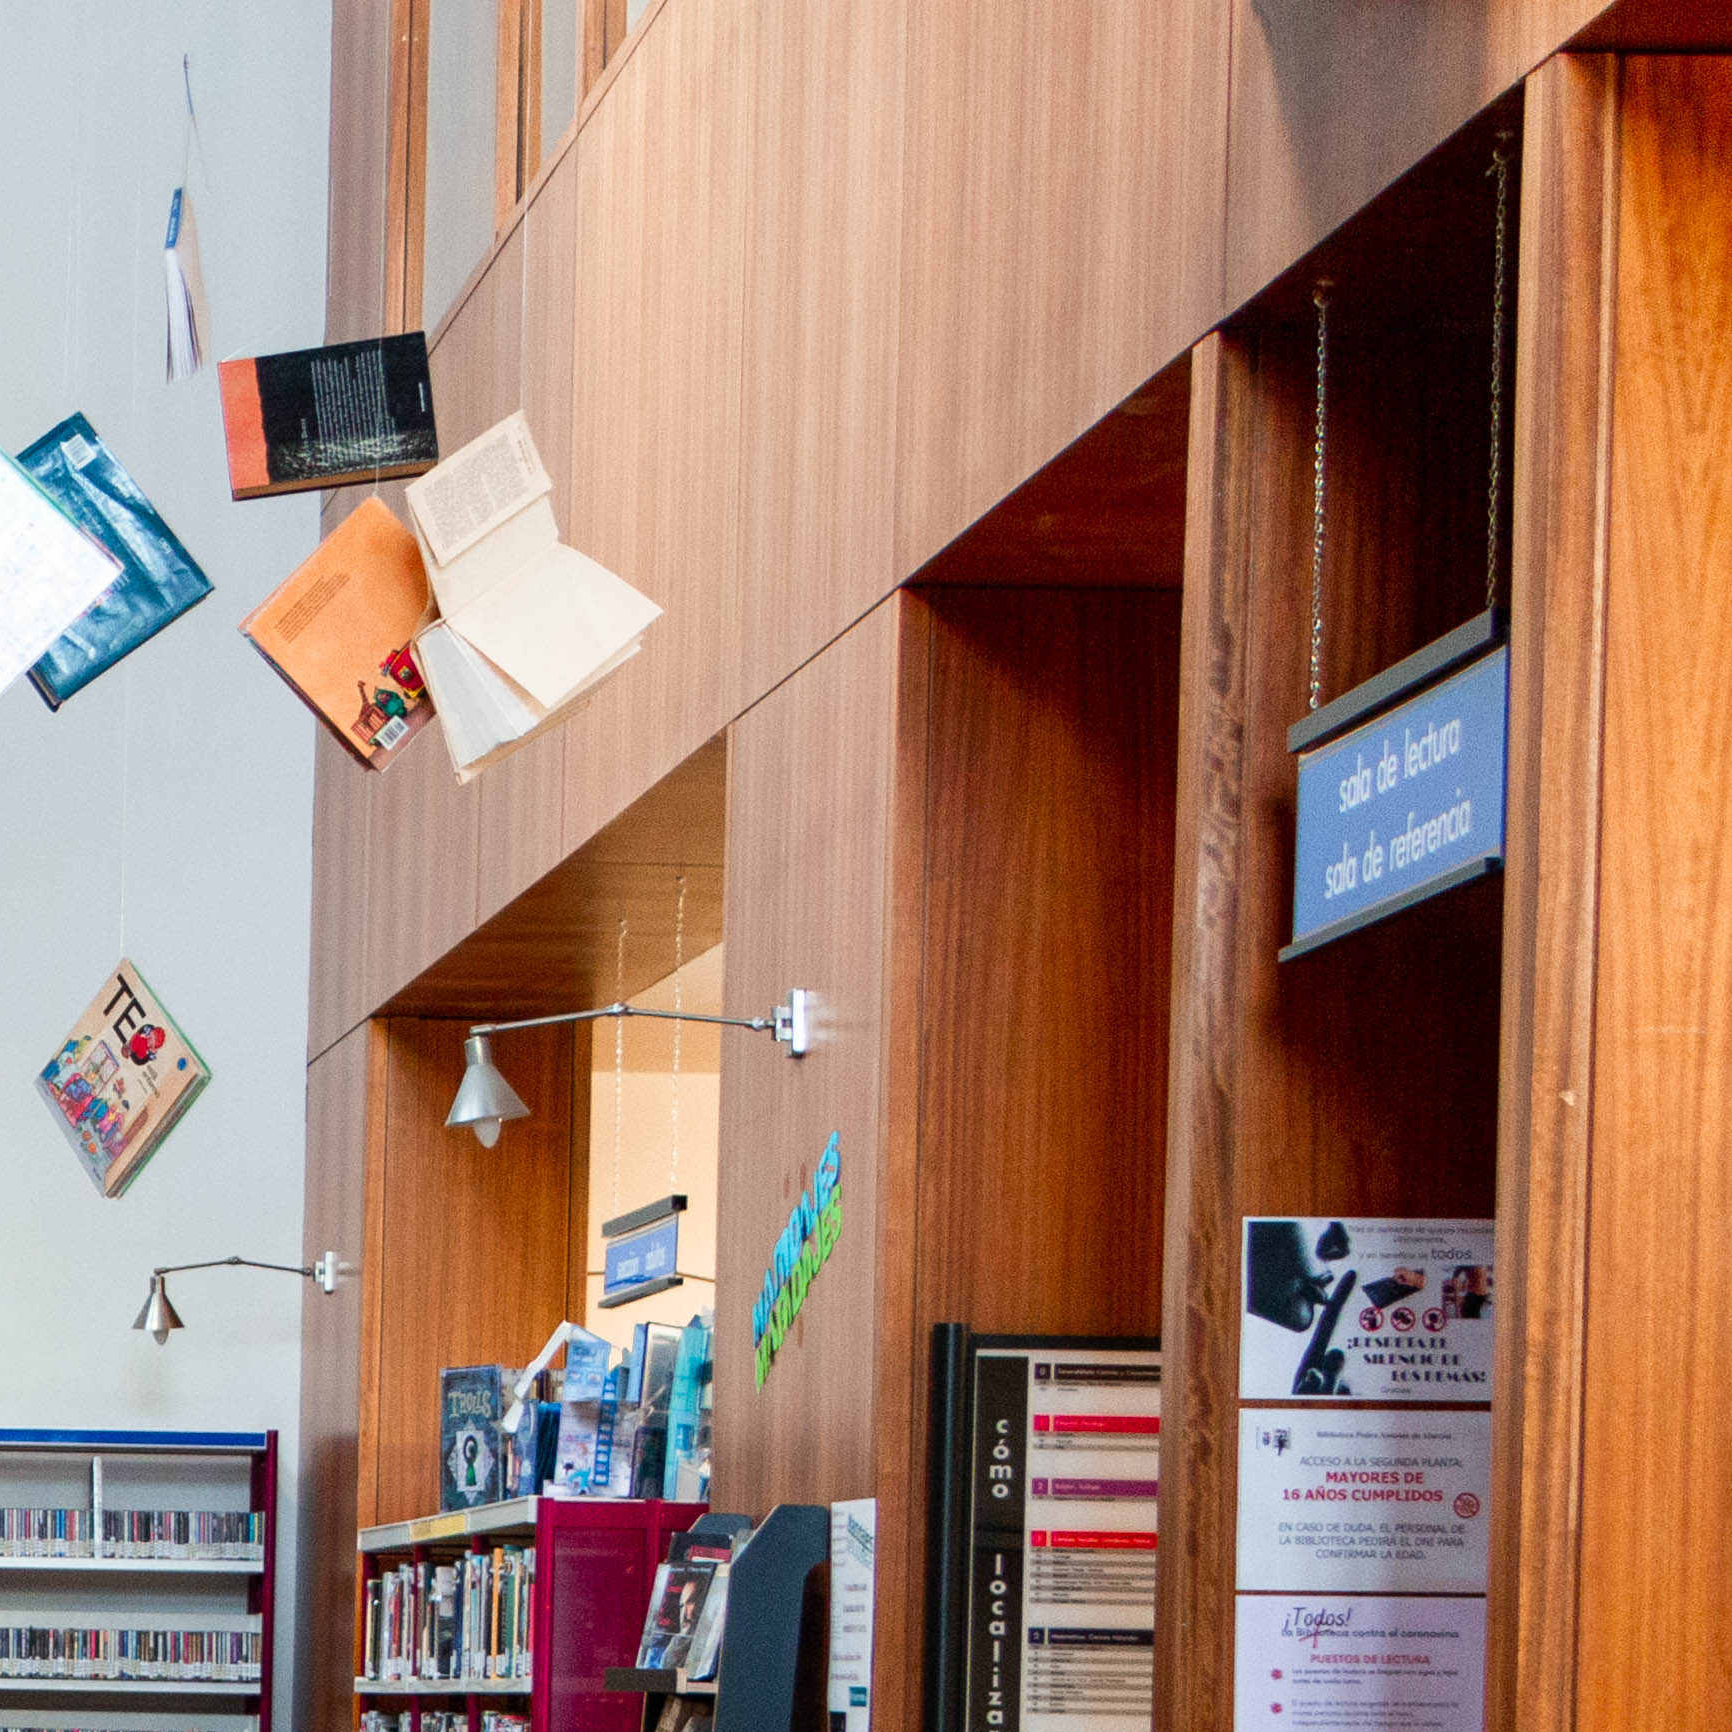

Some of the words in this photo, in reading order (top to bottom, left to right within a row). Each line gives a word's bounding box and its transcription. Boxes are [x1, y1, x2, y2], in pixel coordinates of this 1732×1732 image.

[1339, 754, 1372, 812] sala
[1377, 740, 1397, 792] de
[1404, 719, 1461, 779] lectura
[1325, 843, 1357, 898] sala
[1363, 830, 1383, 882] de
[1389, 788, 1472, 872] referencia
[1283, 1489, 1300, 1501] 16
[1305, 1485, 1347, 1501] AÑOS
[1351, 1489, 1444, 1502] CUMPLIDOS
[1326, 1472, 1399, 1484] MAYORES
[1404, 1472, 1424, 1484] DE
